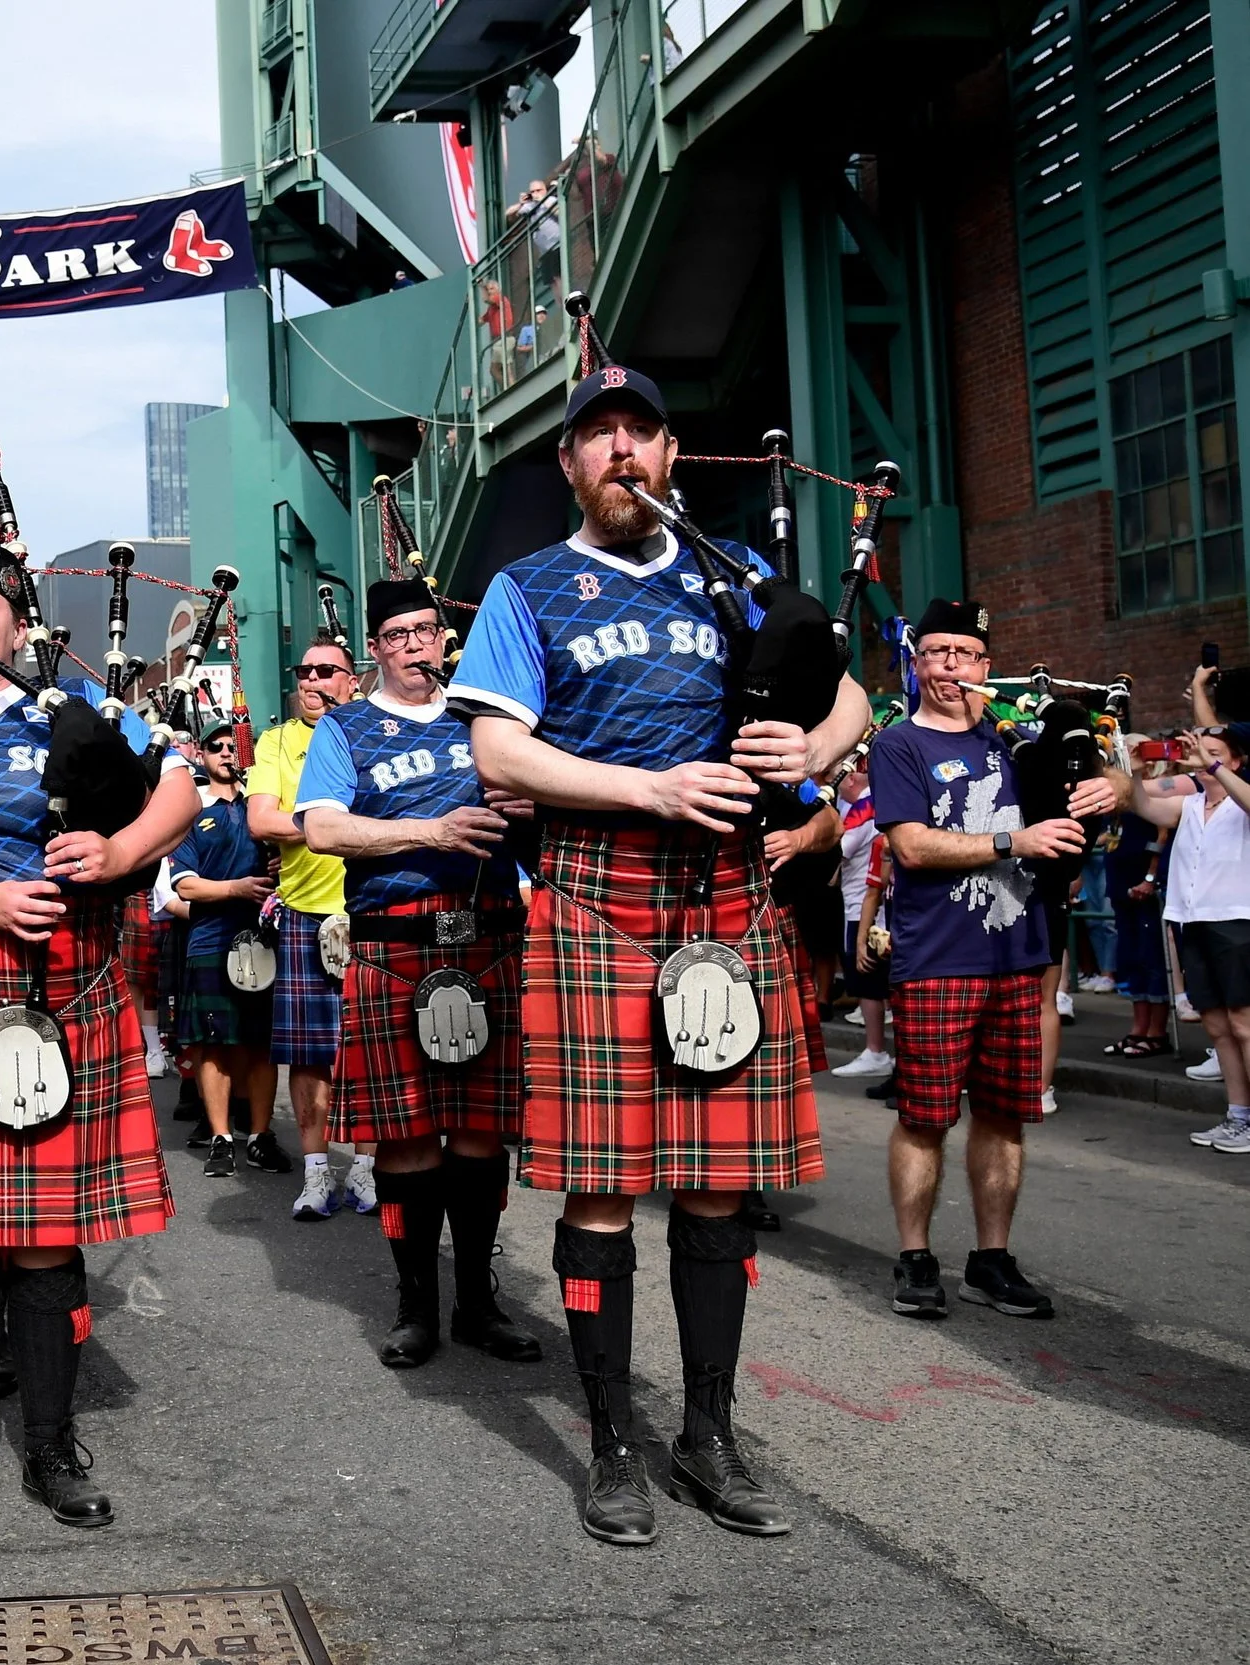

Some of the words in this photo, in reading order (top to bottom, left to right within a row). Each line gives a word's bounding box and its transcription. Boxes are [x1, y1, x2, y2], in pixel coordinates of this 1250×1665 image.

[601, 366, 627, 389] B
[574, 573, 602, 601] B
[566, 620, 649, 674] RED
[379, 719, 400, 737] B
[7, 745, 50, 774] SO
[369, 749, 436, 794] RED
